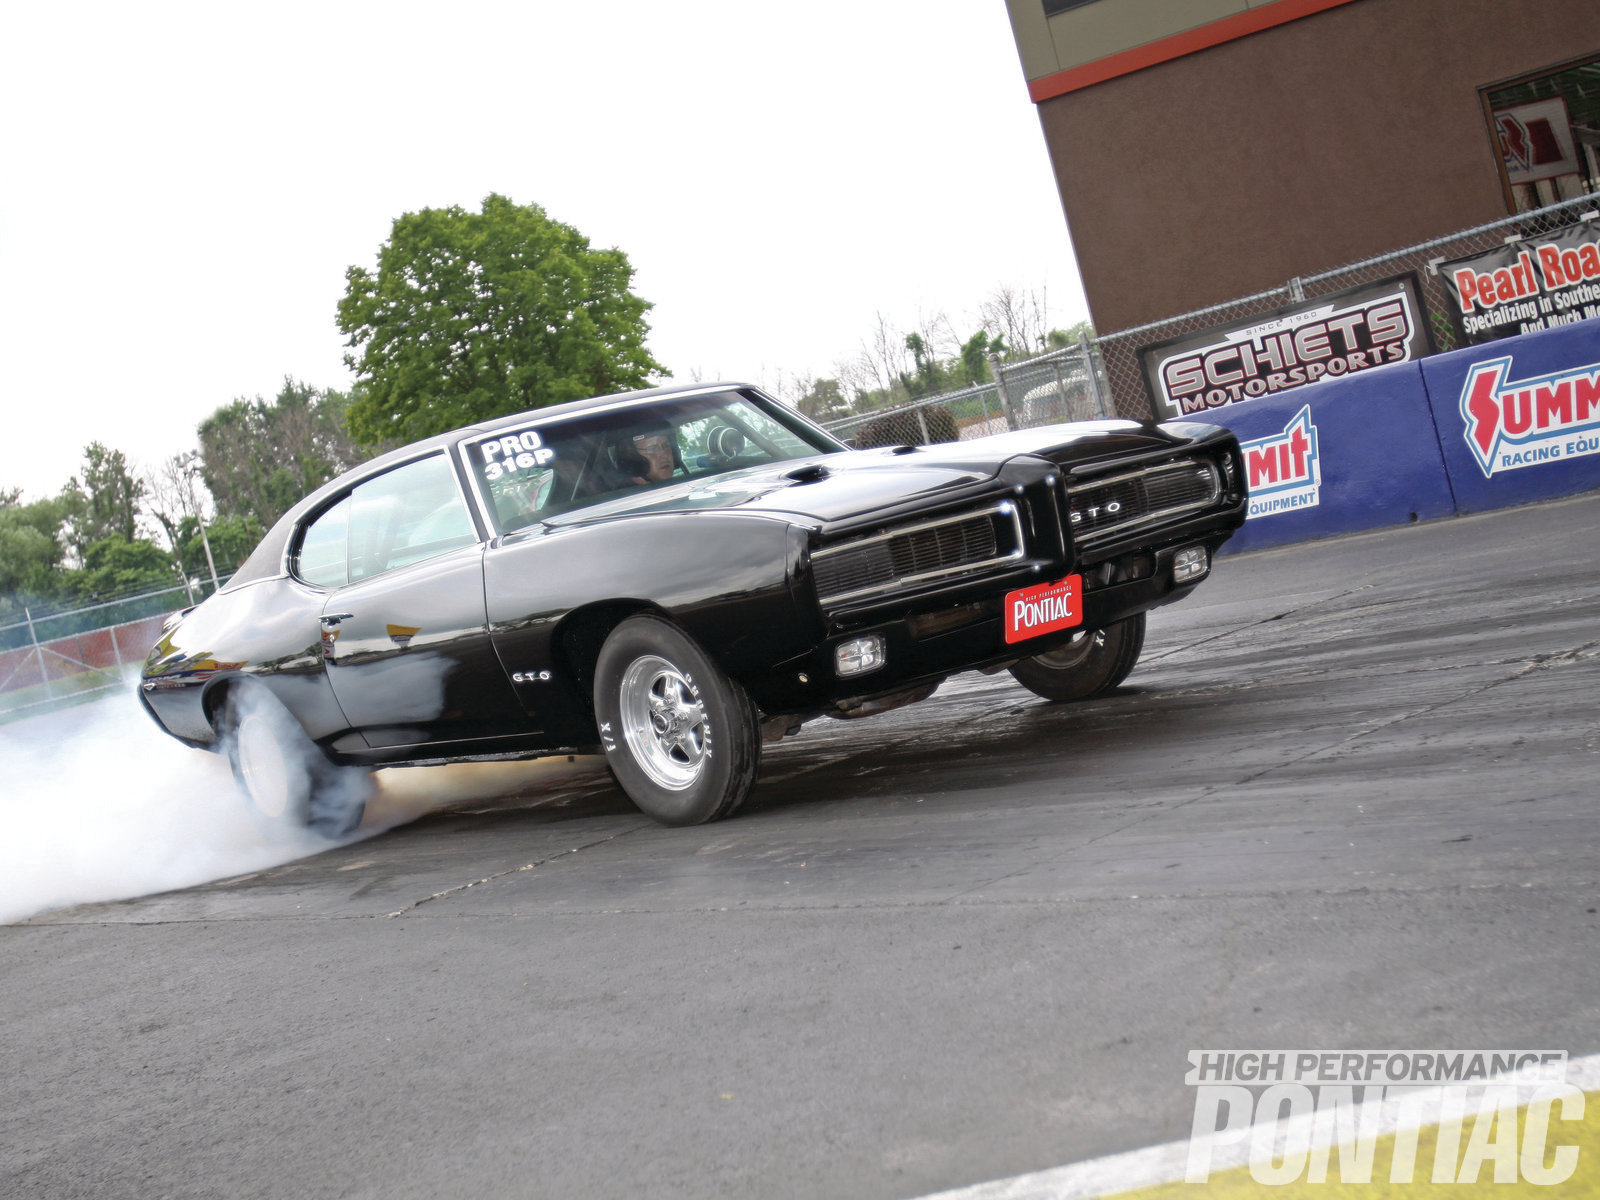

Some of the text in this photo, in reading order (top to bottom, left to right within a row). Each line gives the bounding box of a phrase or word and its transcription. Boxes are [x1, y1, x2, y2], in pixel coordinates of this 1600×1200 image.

[1454, 239, 1600, 313] Pearl Roa
[1246, 311, 1317, 335] SINCE 1960
[1463, 283, 1600, 334] Specializing in Southe
[1166, 302, 1406, 397] SCHIETS
[1182, 341, 1405, 413] MOTORSPORTS
[481, 431, 541, 464] PRO
[1502, 445, 1560, 467] RACING
[484, 448, 554, 480] 316P
[1070, 502, 1120, 522] GTO
[1248, 492, 1316, 515] QUIPMENT
[1014, 592, 1073, 631] PONTIAC
[512, 670, 551, 682] GTO
